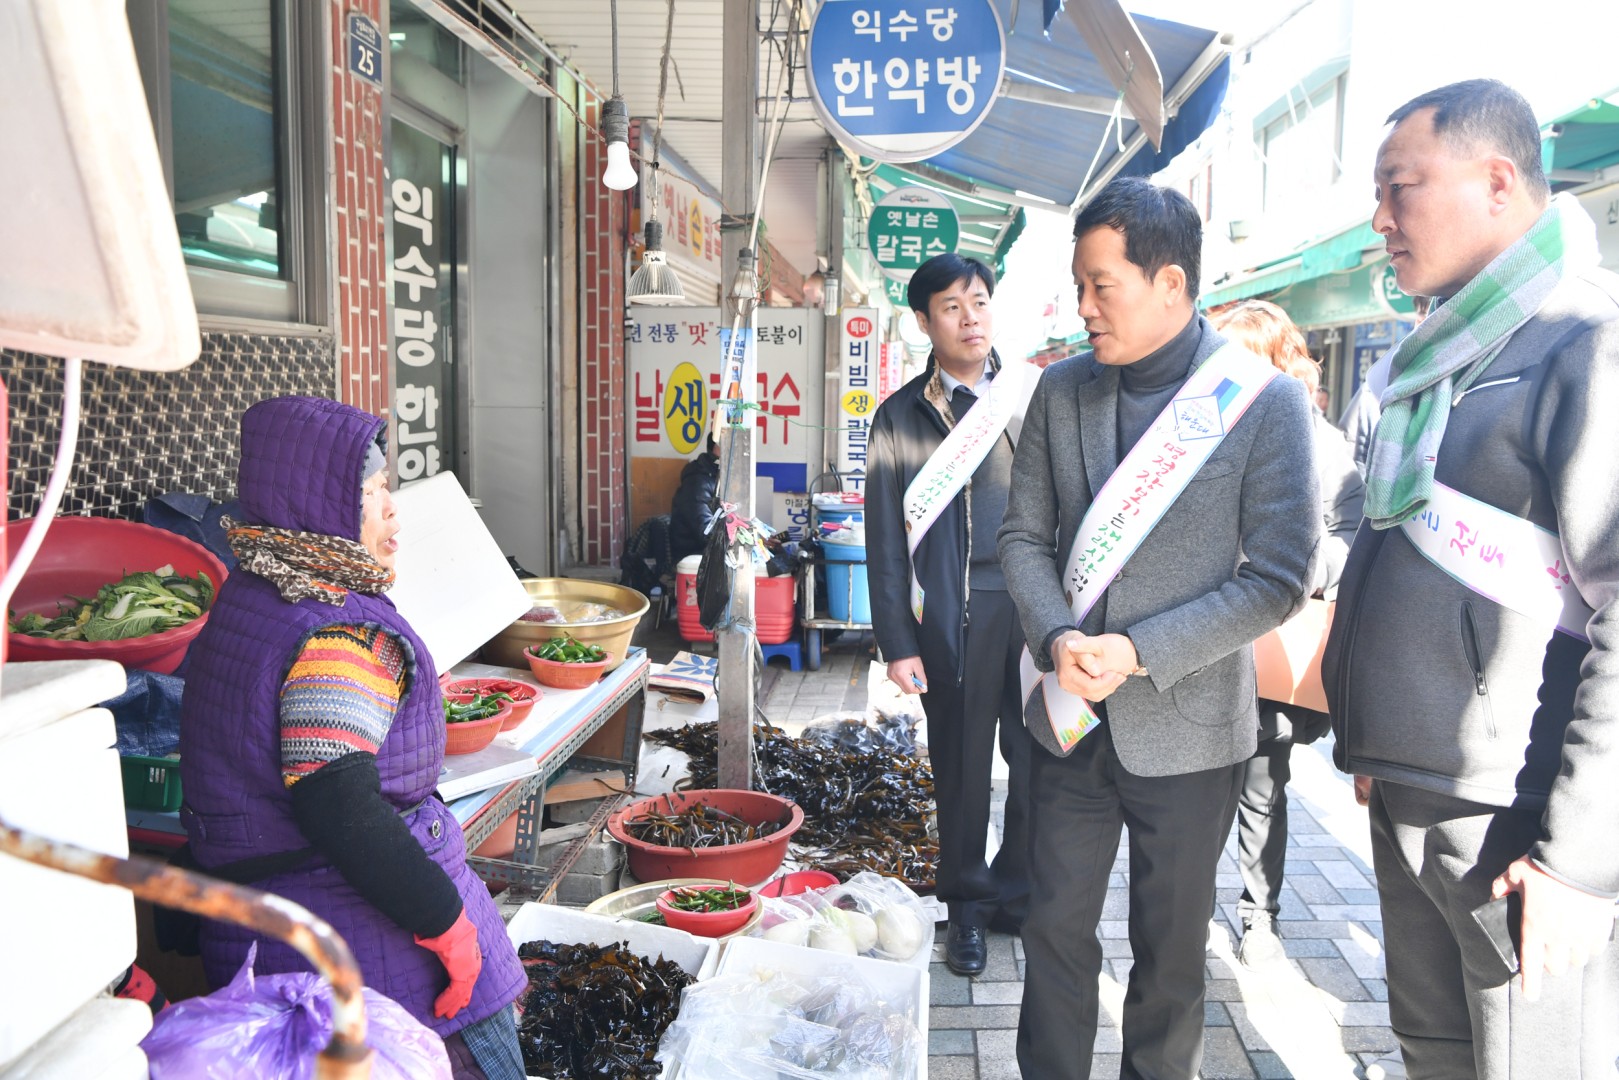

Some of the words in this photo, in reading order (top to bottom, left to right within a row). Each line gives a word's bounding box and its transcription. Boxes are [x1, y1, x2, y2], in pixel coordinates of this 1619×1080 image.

[851, 7, 958, 43] 익수당
[358, 45, 374, 76] 25
[832, 56, 982, 117] 한약방
[887, 210, 939, 229] 옛날손
[391, 178, 437, 367] 익수당
[648, 323, 680, 343] 전통
[850, 320, 869, 336] 특미
